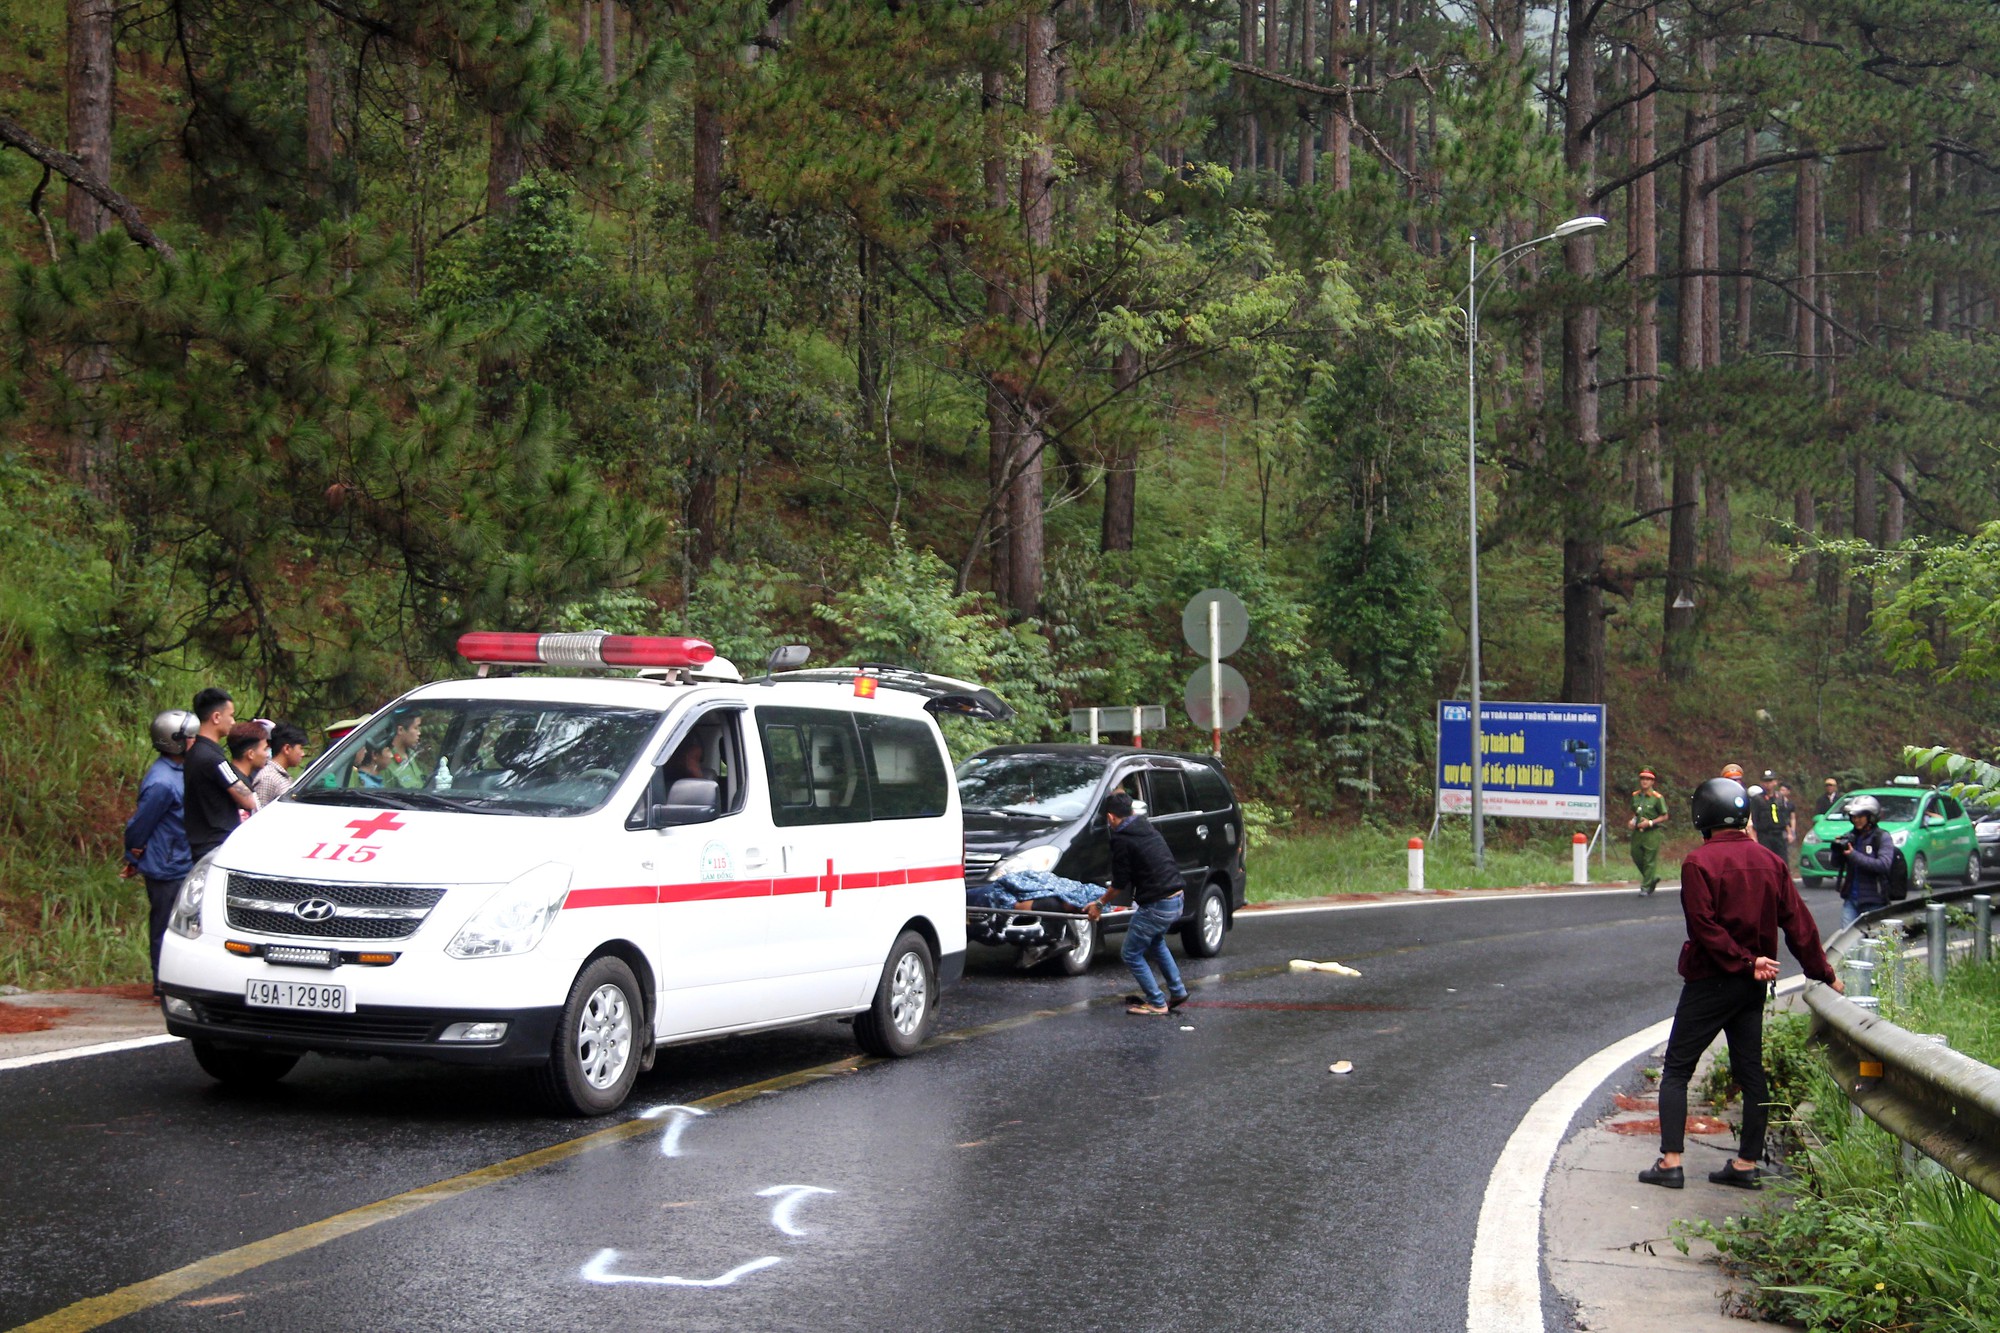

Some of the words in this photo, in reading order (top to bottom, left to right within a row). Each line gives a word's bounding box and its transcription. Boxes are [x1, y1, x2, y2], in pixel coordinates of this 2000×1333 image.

[1491, 709, 1507, 720] TOÀN
[1508, 711, 1524, 720] GIAO
[1525, 711, 1546, 721] THÔNG
[1563, 712, 1577, 722] LÂM
[1444, 764, 1459, 784] quy
[1543, 768, 1555, 787] xe
[302, 842, 383, 863] 115
[714, 857, 727, 869] 115
[250, 983, 343, 1009] 49A-129.98
